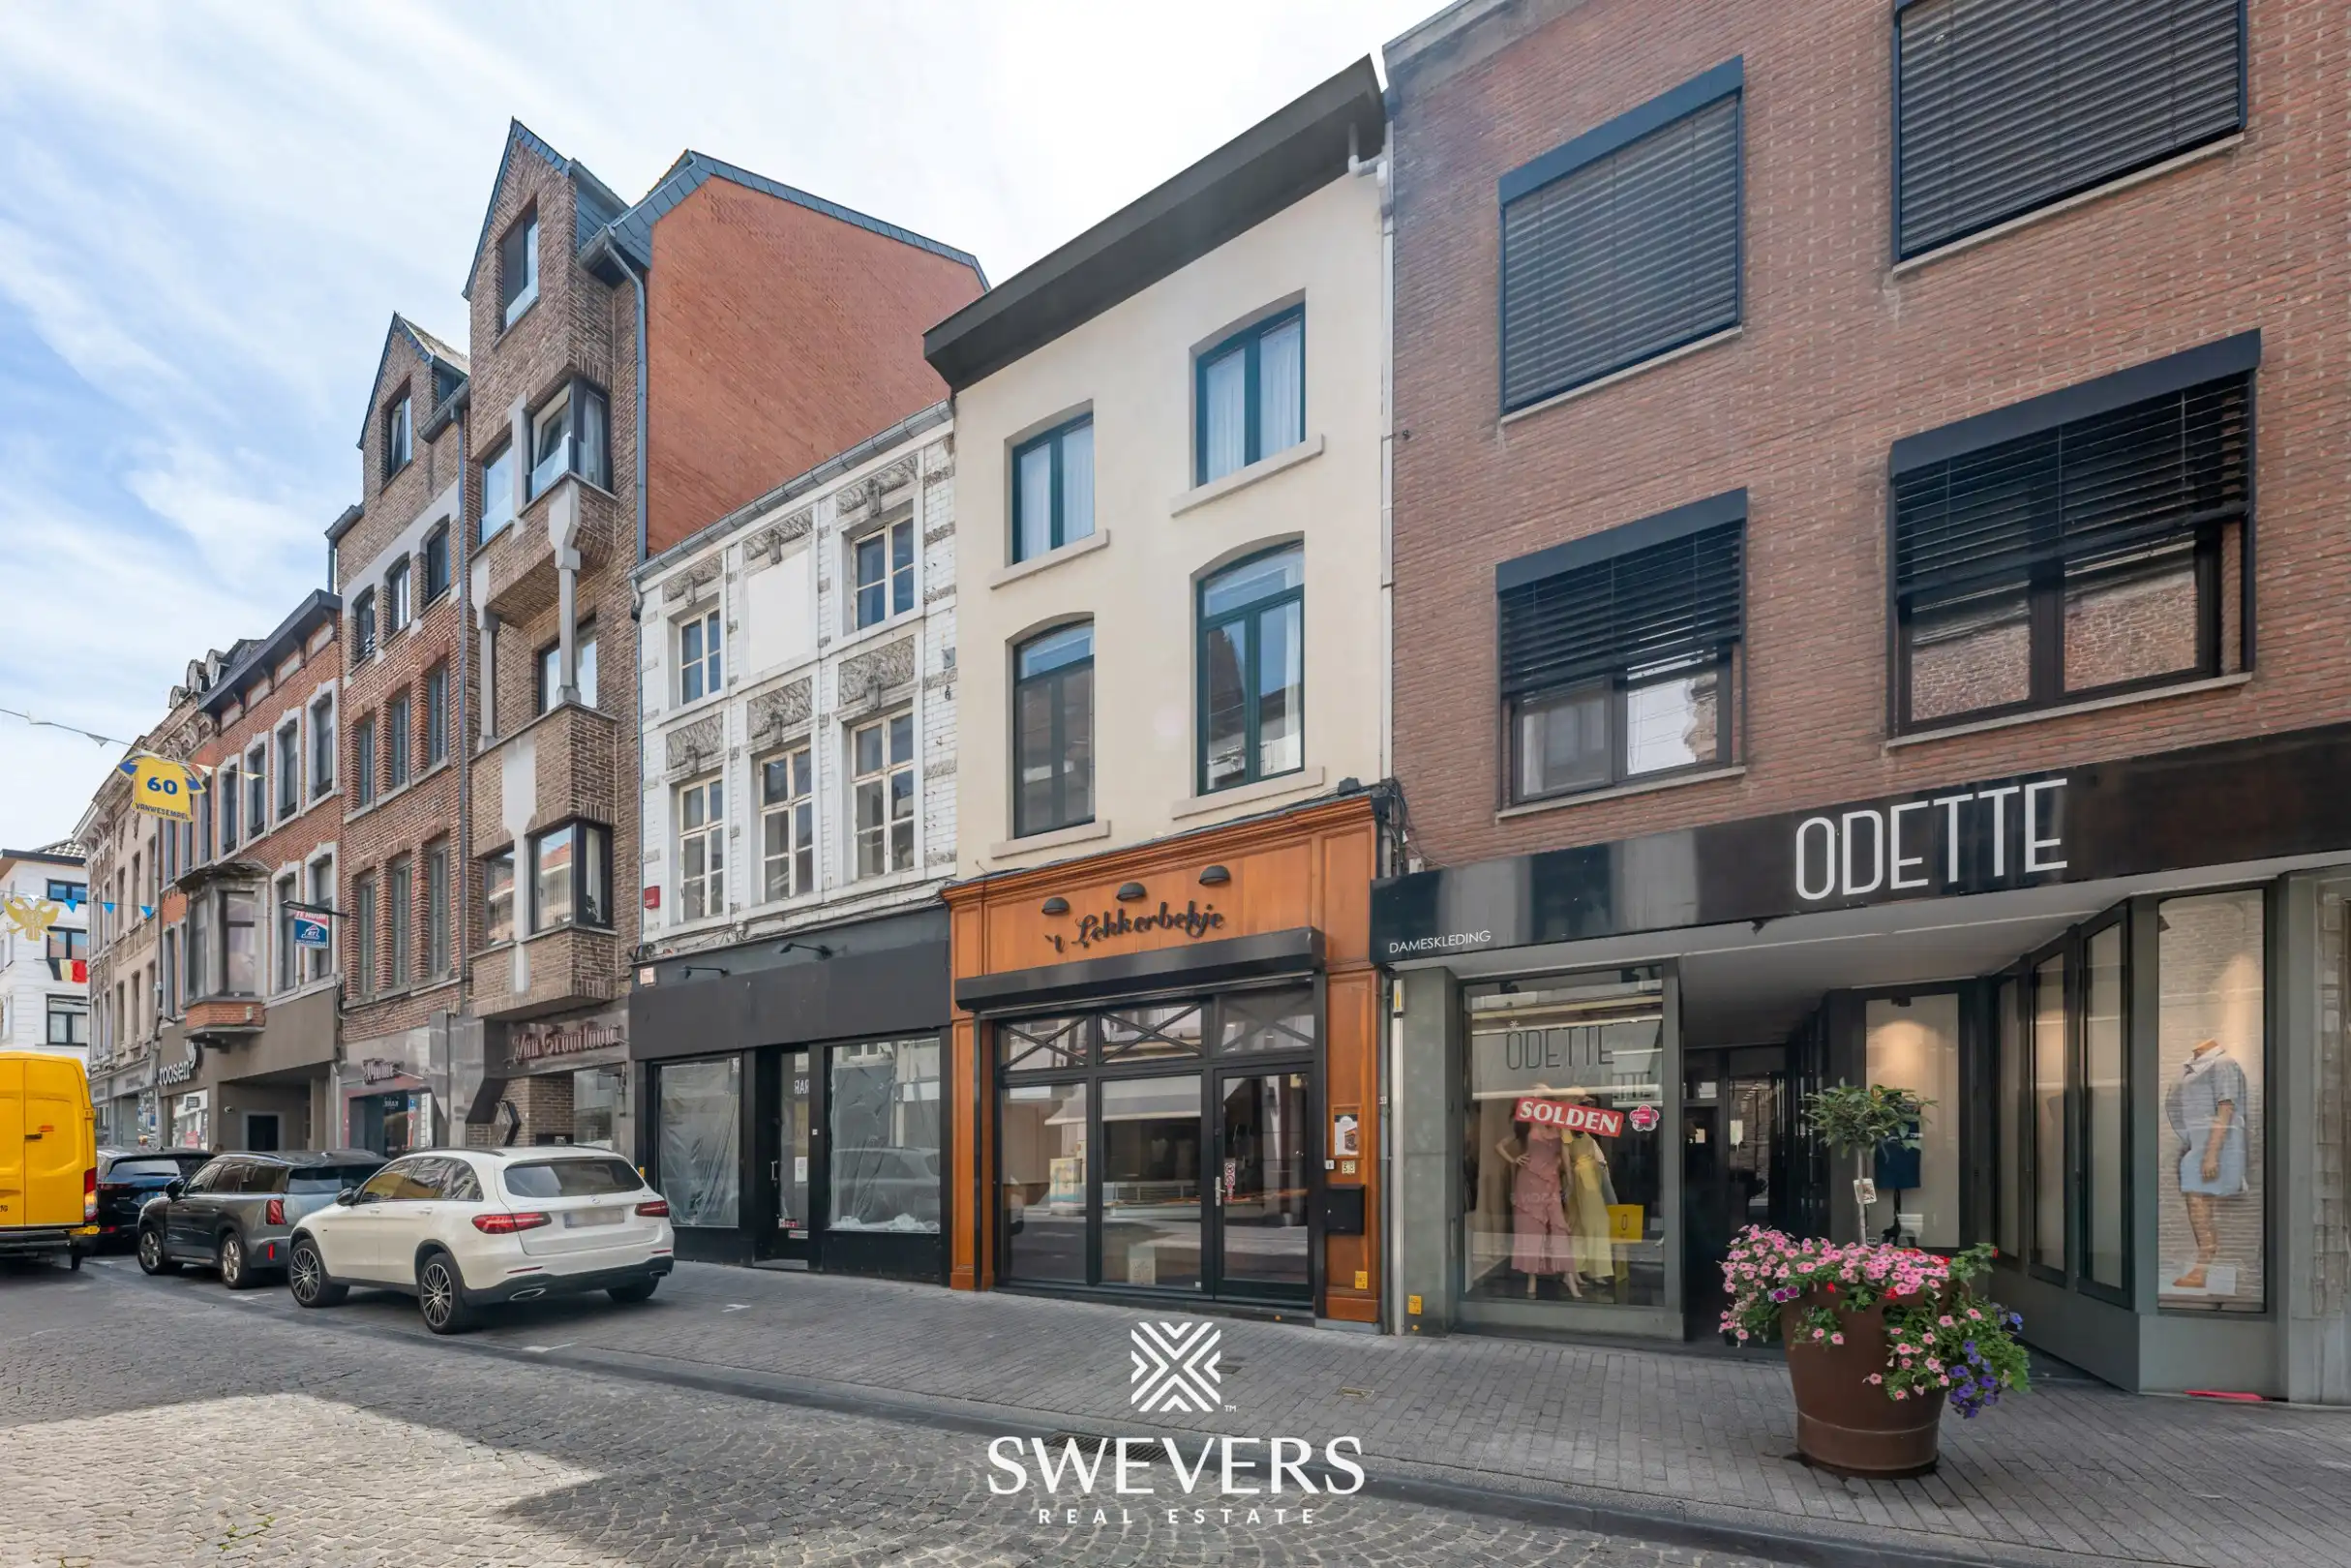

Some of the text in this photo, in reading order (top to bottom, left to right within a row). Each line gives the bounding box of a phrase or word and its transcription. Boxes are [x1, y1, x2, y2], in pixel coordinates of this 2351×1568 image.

[147, 776, 178, 796] 60
[1795, 778, 2067, 900] ODETTE
[1071, 900, 1225, 950] Lekkerbekje
[1389, 930, 1492, 954] DAMESKLEDING
[1506, 1026, 1614, 1070] ODETTE
[158, 1060, 190, 1085] roosen
[1520, 1101, 1619, 1133] SOLDEN
